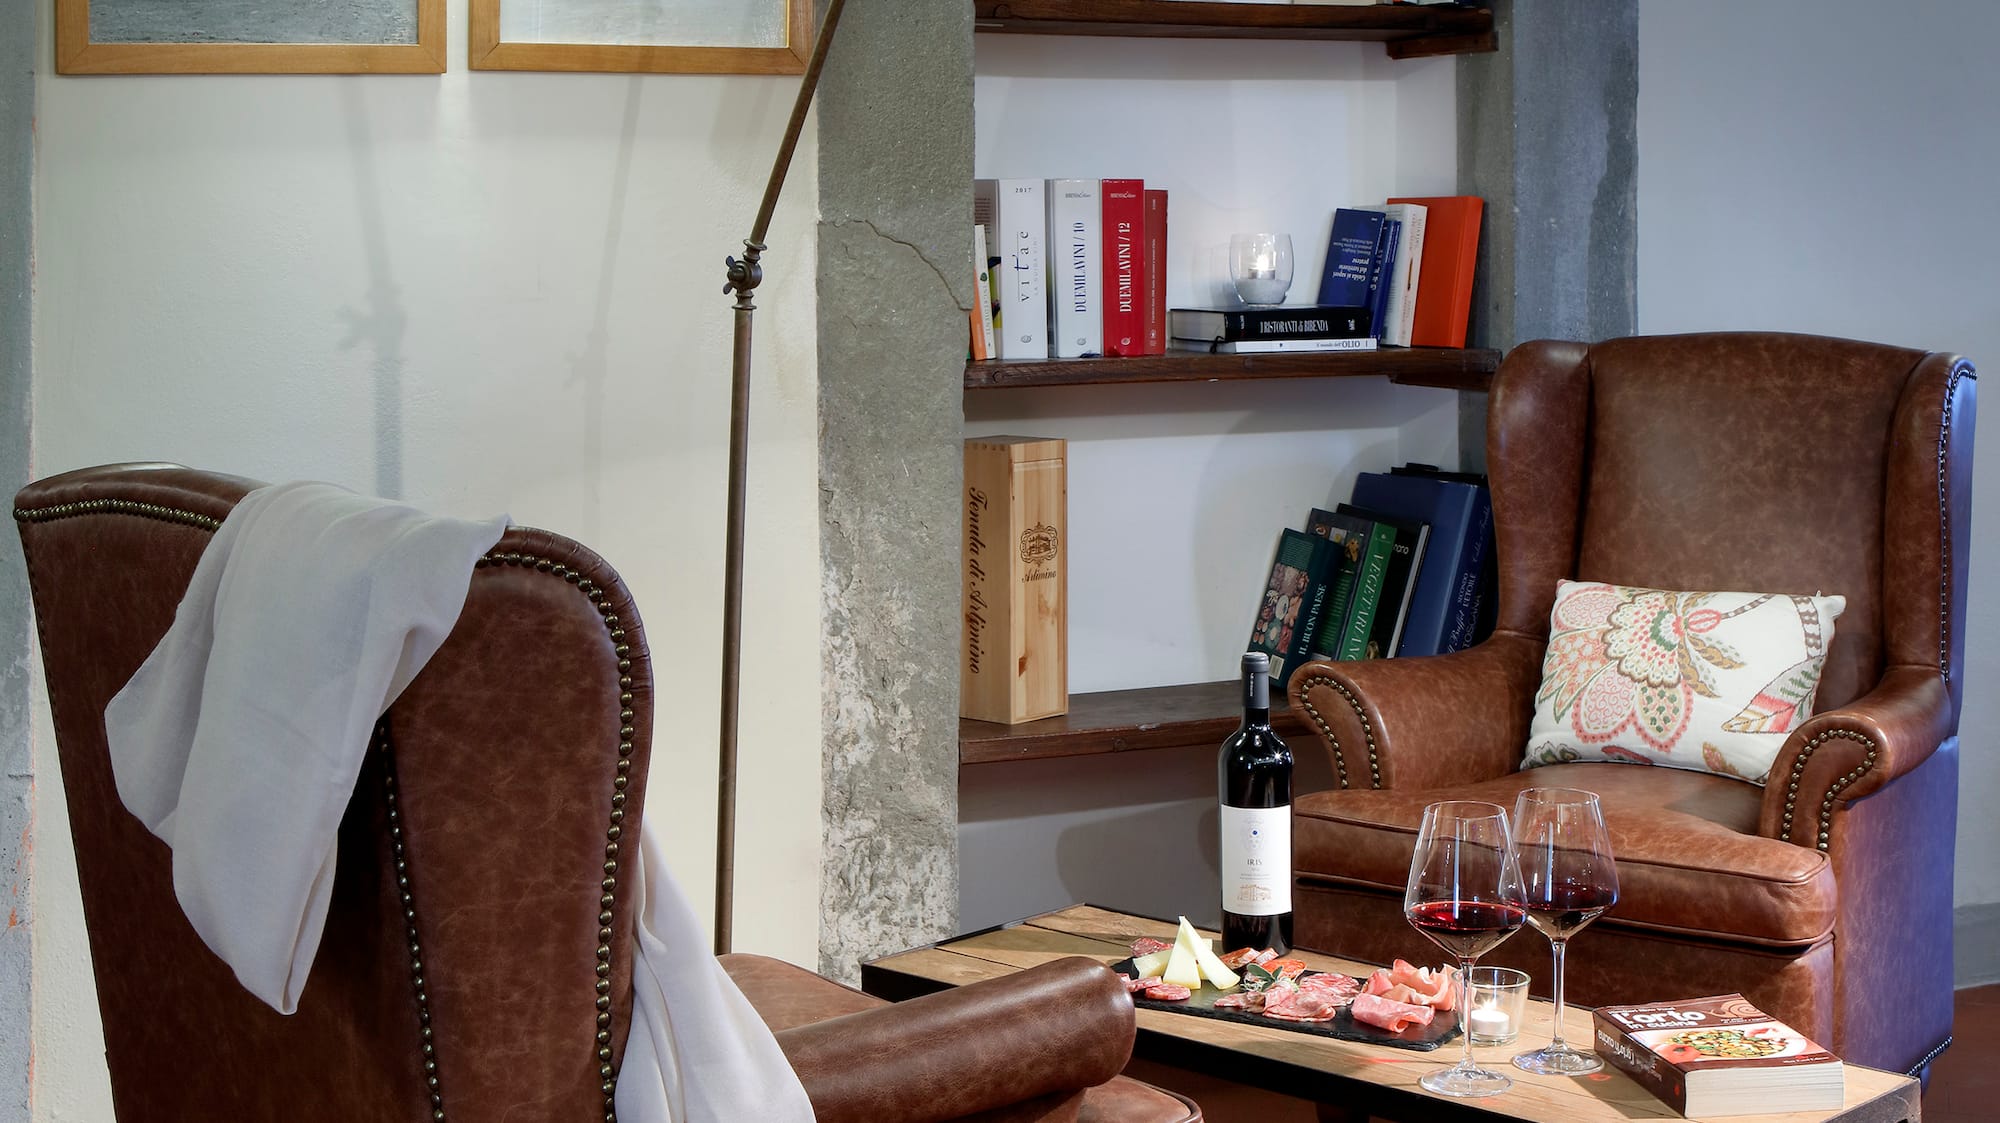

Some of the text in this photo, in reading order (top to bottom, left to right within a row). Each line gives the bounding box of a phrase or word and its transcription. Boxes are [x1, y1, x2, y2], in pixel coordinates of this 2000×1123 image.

[1072, 222, 1085, 232] 10
[1118, 222, 1131, 233] 12
[1012, 231, 1030, 303] vitae
[1332, 270, 1346, 278] sapori
[1073, 244, 1087, 312] DUEMILAVINI
[1118, 244, 1132, 312] DUEMILAVINI
[1352, 274, 1366, 282] Guida
[1264, 320, 1297, 333] RISTORANTI
[1304, 320, 1329, 332] BIBENDA
[968, 487, 987, 674] Tenuta di Artimino
[1298, 583, 1327, 655] IL BUON PAESE
[1461, 594, 1482, 649] TOSCANA
[1247, 858, 1262, 866] IRIS
[1611, 1010, 1706, 1025] L'orto
[1627, 1020, 1698, 1029] in cucina
